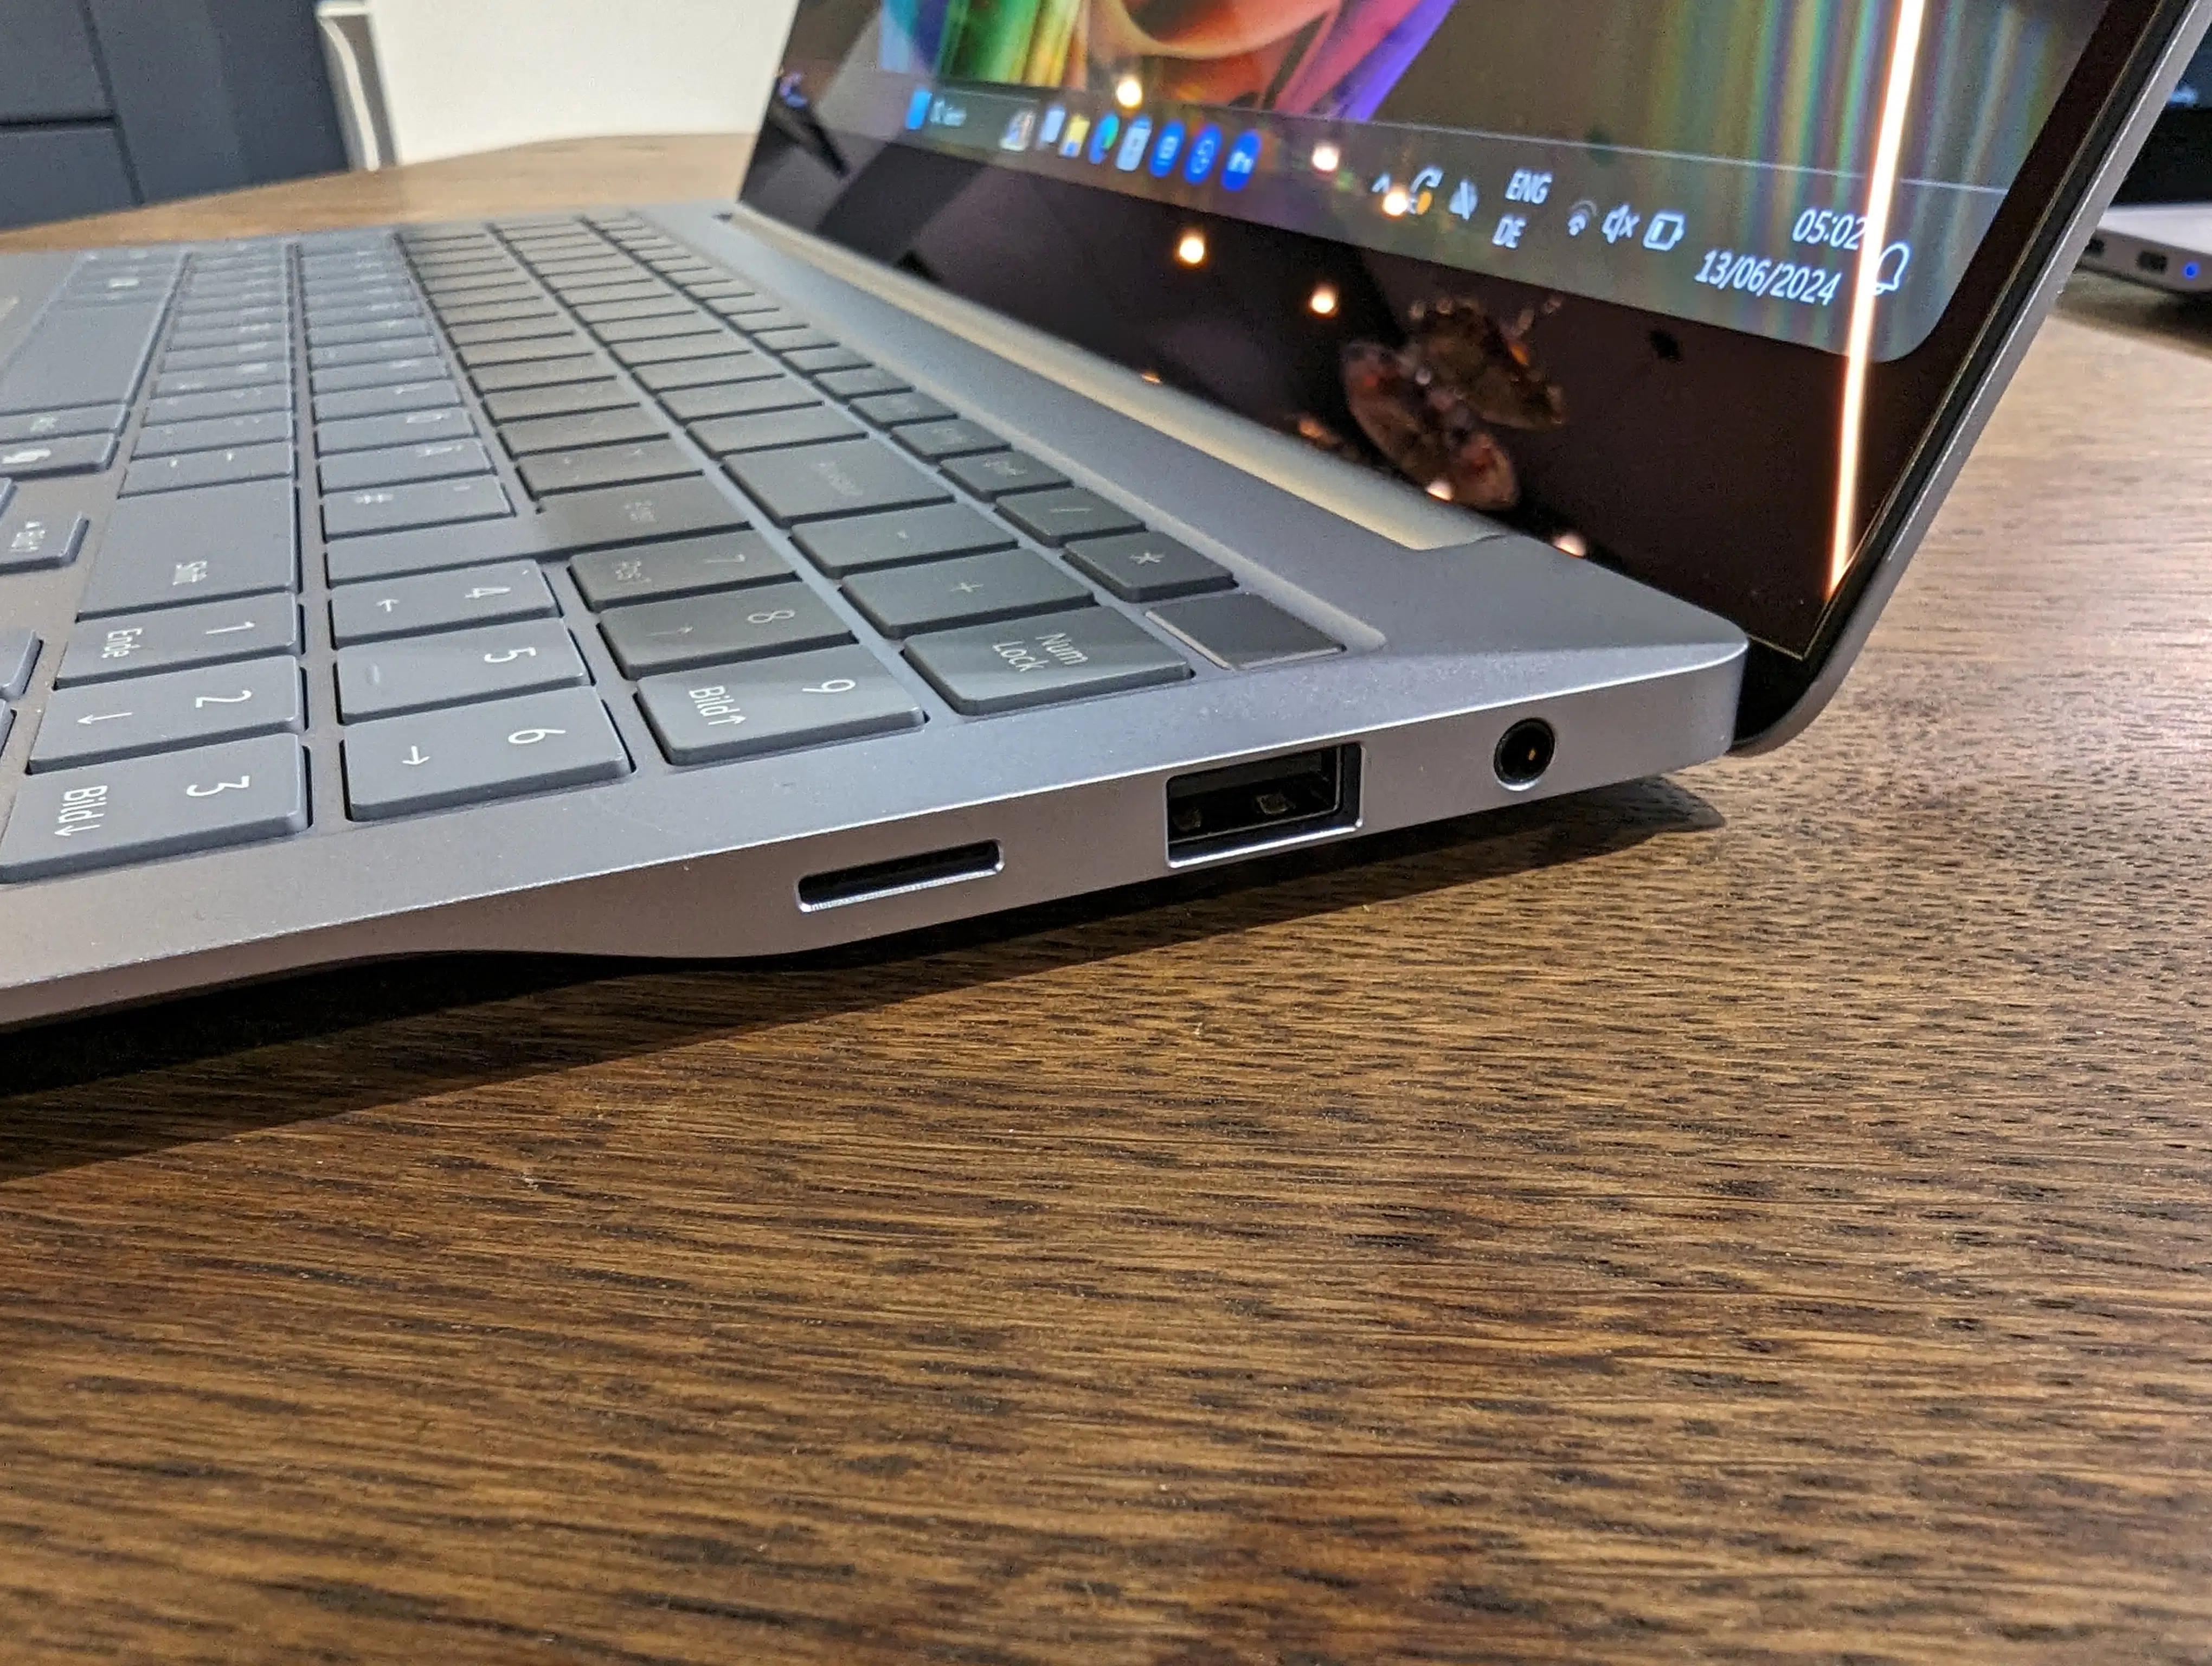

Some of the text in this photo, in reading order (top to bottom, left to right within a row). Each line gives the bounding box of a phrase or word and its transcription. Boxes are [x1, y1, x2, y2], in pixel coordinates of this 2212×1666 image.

[1505, 169, 1553, 204] ENG
[1492, 215, 1527, 248] DE
[1792, 209, 1868, 250] 05:02
[1694, 249, 1842, 306] 13/06/2024
[465, 587, 511, 599] 4
[206, 621, 255, 635] 1
[747, 609, 796, 624] 8
[484, 647, 536, 663] 5
[992, 640, 1050, 672] Lock
[1035, 632, 1089, 665] Num
[195, 690, 252, 708] 2
[802, 678, 856, 694] 9
[689, 685, 741, 717] Bild
[508, 729, 566, 744] 6
[186, 775, 249, 797] 3
[59, 785, 108, 823] Bild
